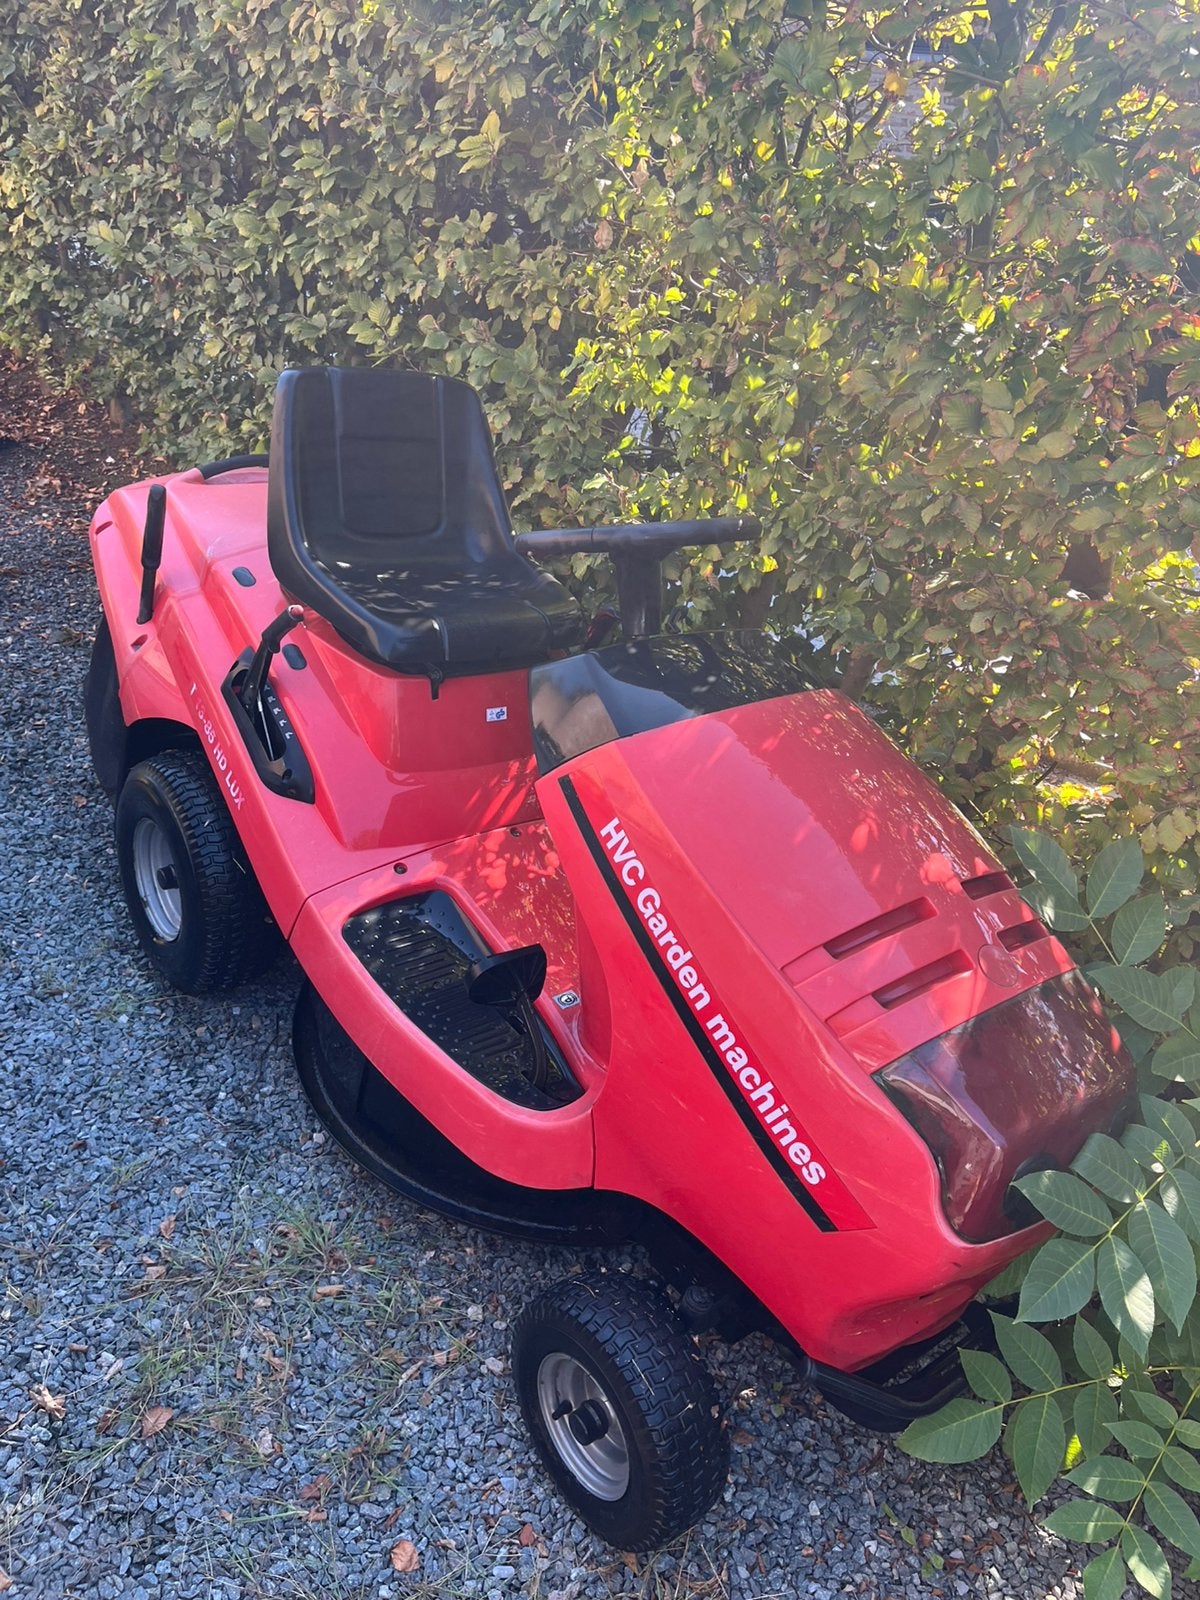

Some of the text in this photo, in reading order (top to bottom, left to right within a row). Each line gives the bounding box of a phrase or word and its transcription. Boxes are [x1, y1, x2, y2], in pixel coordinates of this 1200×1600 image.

[213, 742, 227, 771] HD
[225, 769, 246, 811] LUX
[600, 817, 826, 1185] HVC Garden machines
